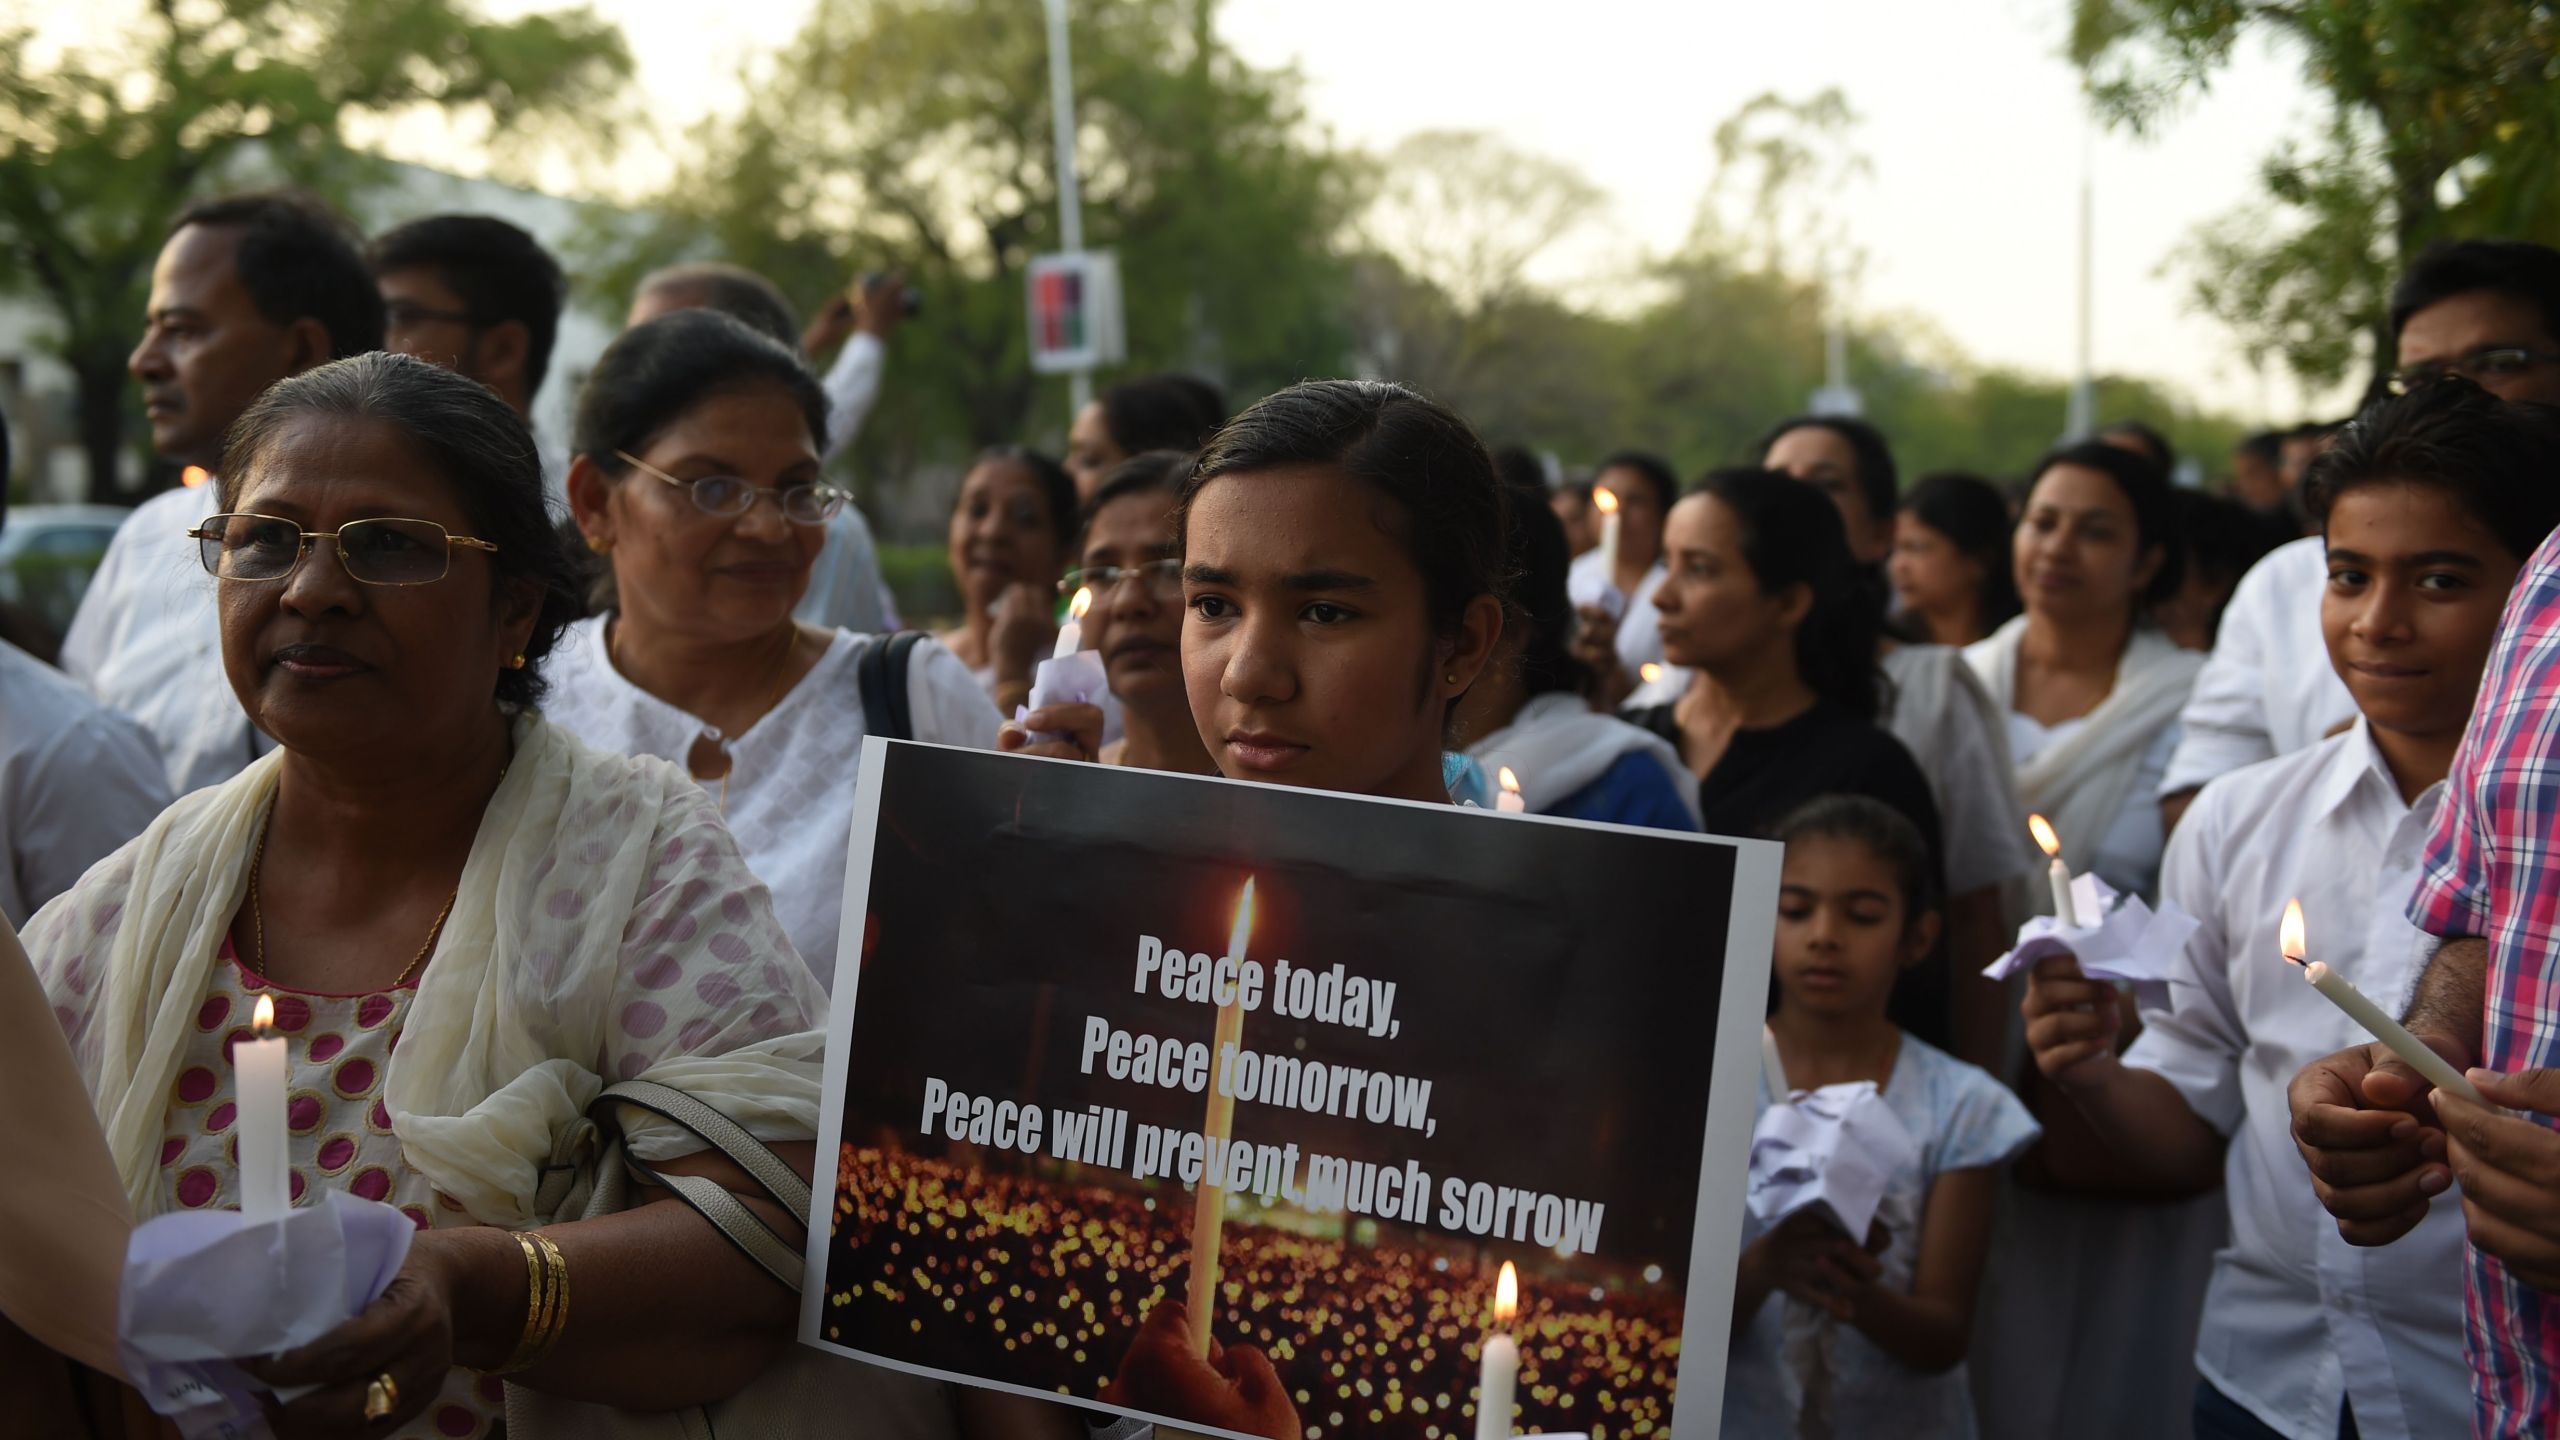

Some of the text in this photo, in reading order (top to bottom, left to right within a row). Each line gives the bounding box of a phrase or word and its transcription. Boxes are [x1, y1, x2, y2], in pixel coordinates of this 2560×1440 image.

[1134, 934, 1400, 1039] Peace today,
[1081, 1016, 1437, 1138] Peace tomorrow,
[920, 1077, 1605, 1254] Peace will prevent much sorrow
